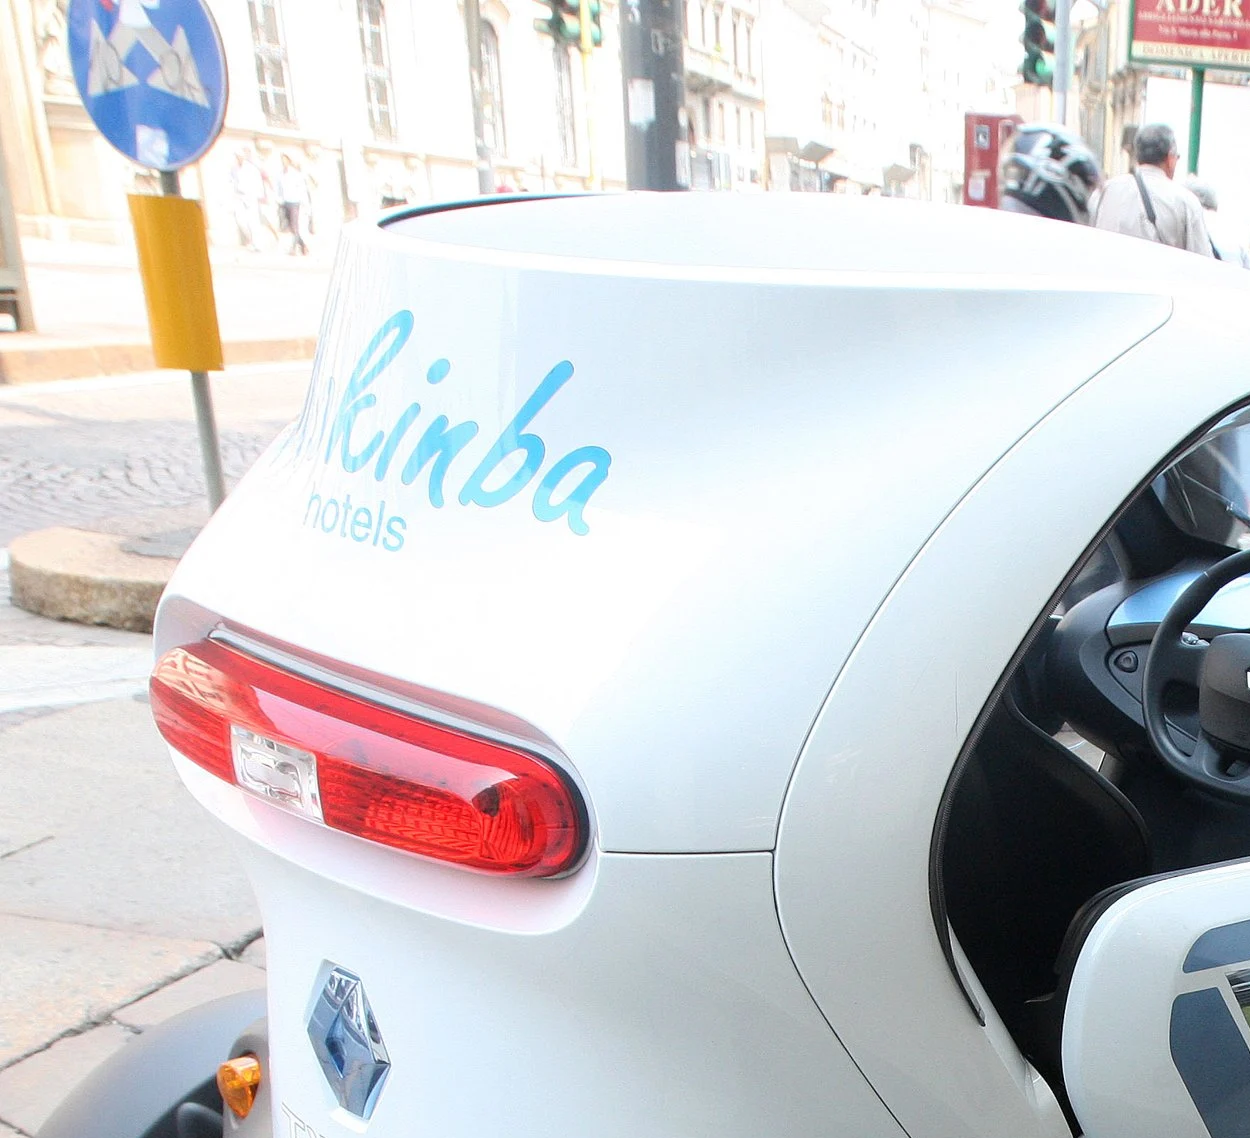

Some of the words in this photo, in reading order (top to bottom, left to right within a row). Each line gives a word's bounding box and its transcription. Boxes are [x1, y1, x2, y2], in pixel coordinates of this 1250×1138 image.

[1156, 0, 1243, 19] ADER
[324, 309, 612, 536] kinba
[303, 491, 408, 552] hotels
